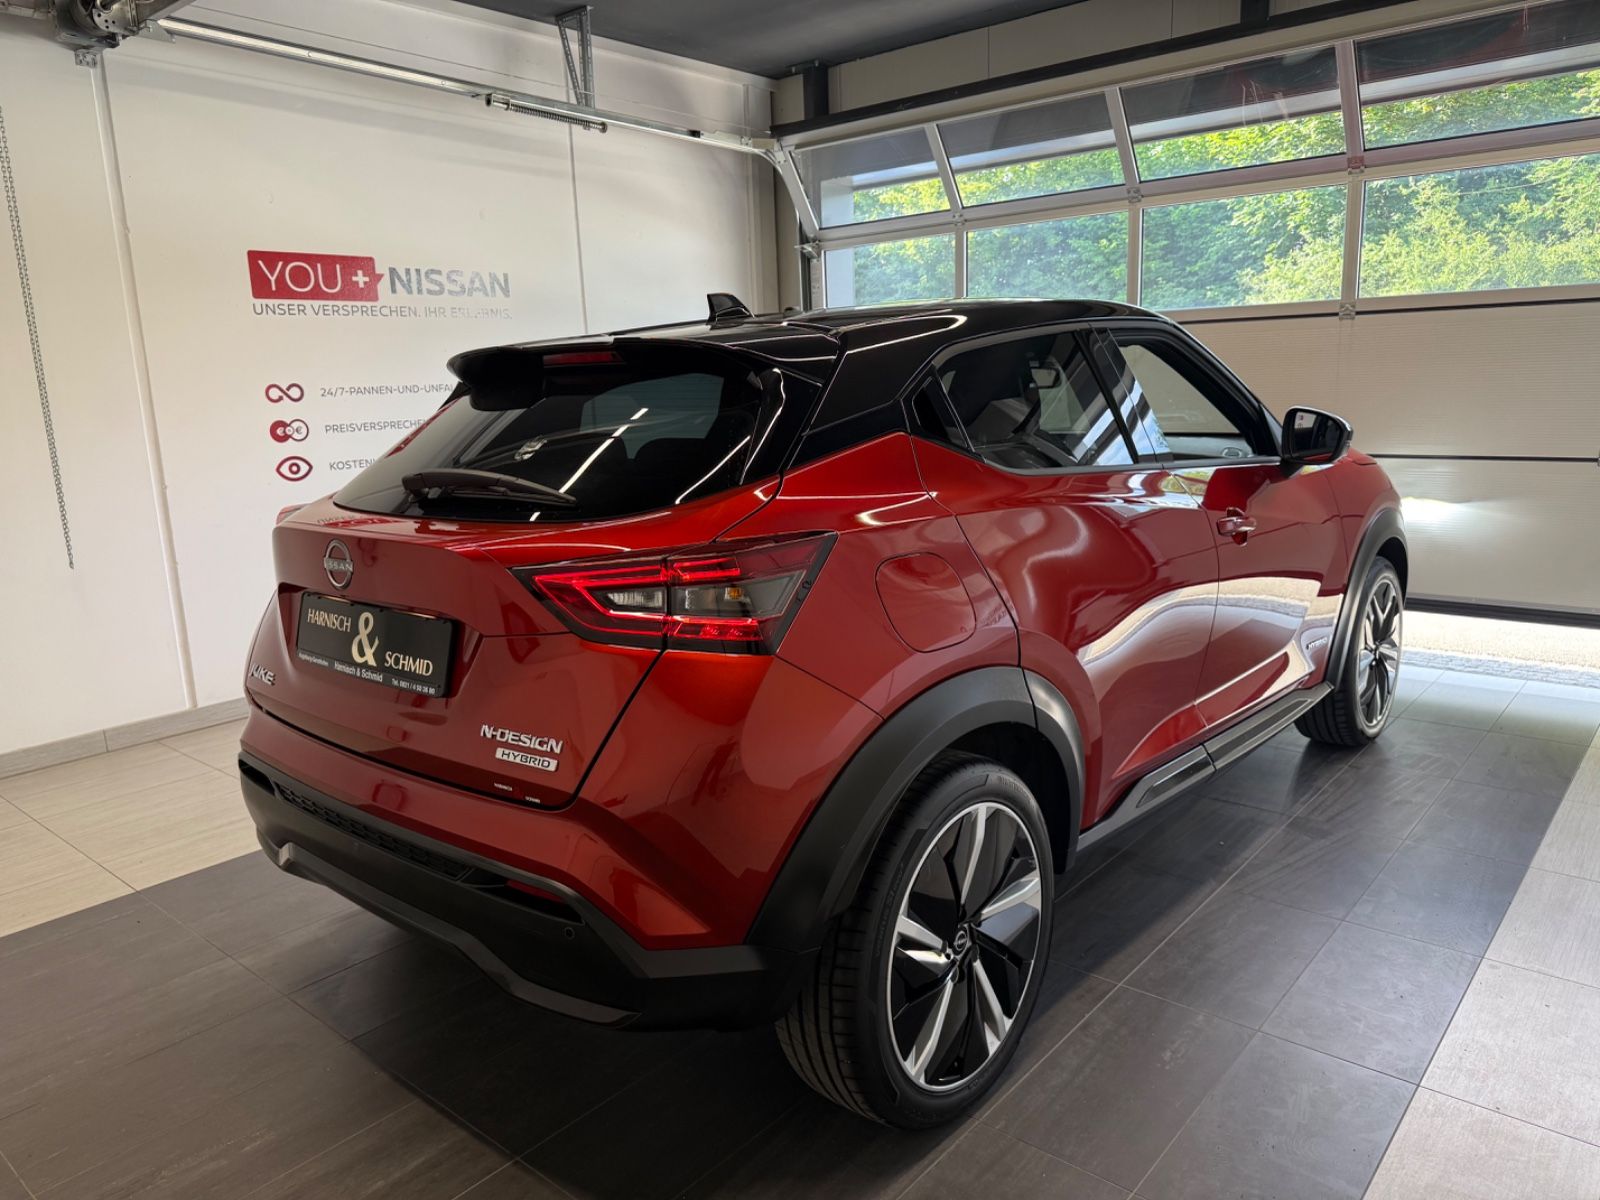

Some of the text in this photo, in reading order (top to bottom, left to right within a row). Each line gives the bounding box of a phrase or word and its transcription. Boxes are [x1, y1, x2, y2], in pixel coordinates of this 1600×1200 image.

[258, 259, 341, 293] YOU
[388, 267, 510, 298] NISSAN
[252, 303, 307, 316] UNSER
[310, 304, 421, 318] VERSPRECHEN.
[425, 305, 447, 318] IHR
[307, 607, 352, 633] HARNISCH
[352, 611, 379, 667] &
[384, 651, 433, 677] SCHMID
[361, 669, 383, 683] Schmid
[480, 724, 563, 754] N-DESIGN
[501, 750, 551, 769] HYBRID
